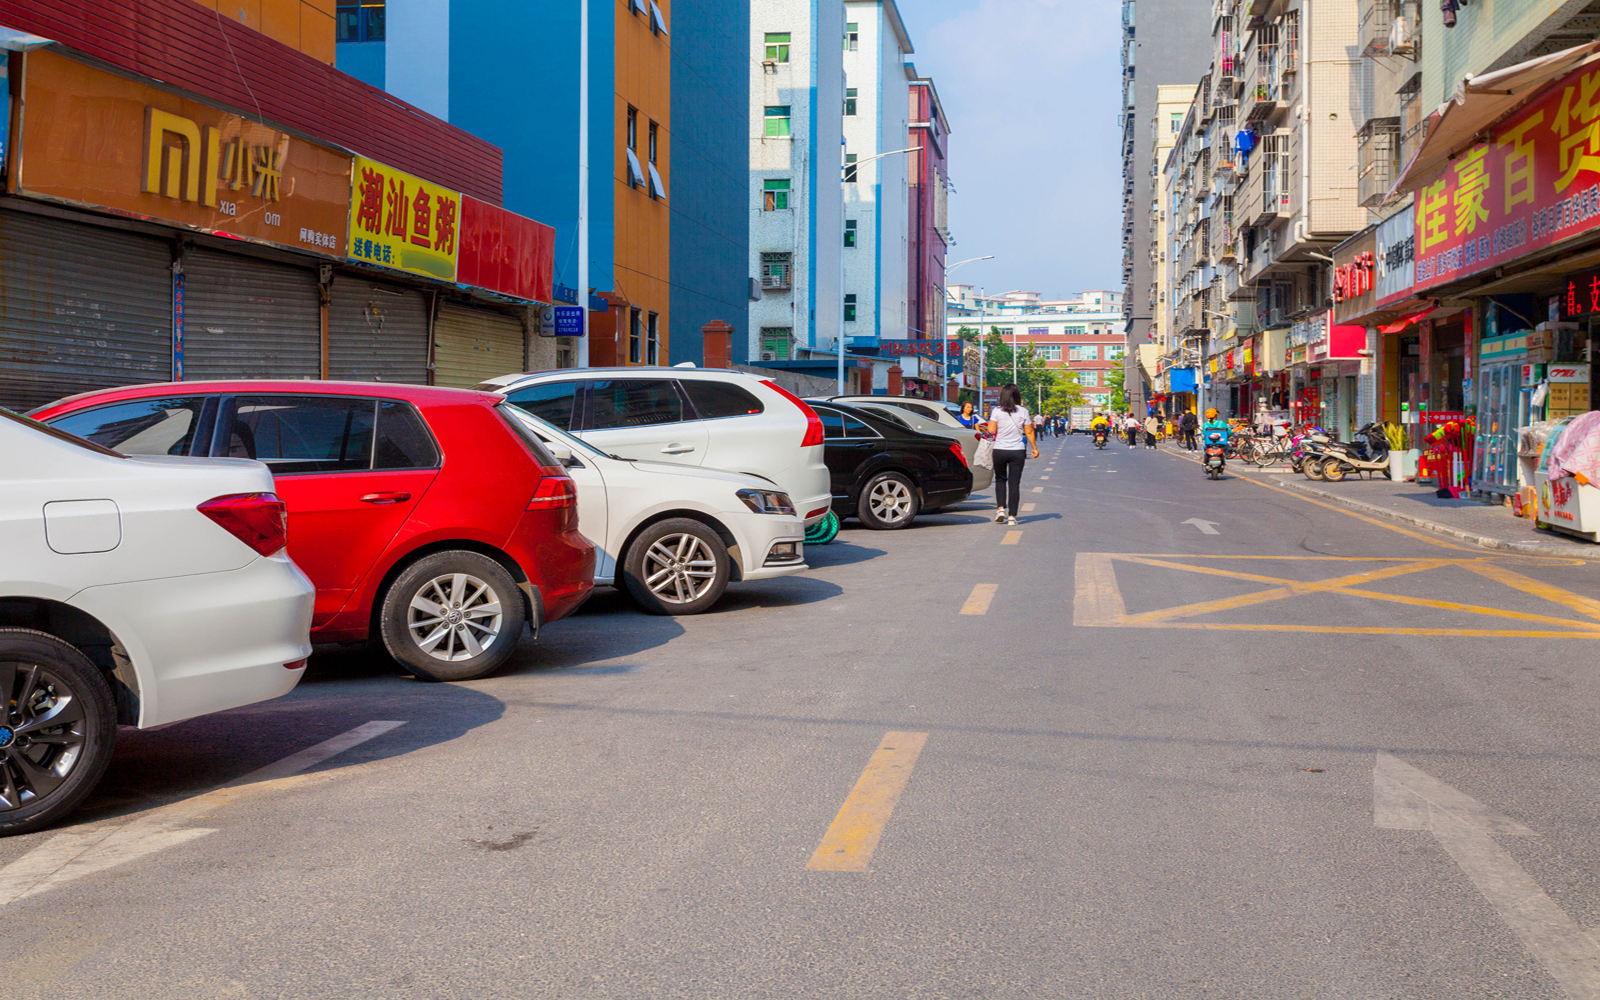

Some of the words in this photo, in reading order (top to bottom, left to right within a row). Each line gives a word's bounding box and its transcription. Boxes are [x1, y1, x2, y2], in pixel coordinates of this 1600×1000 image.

[221, 136, 282, 202] 小米
[1416, 72, 1600, 254] 佳豪百货
[265, 212, 281, 227] om
[300, 228, 336, 249] 网购实体店
[357, 166, 456, 255] 潮汕鱼粥
